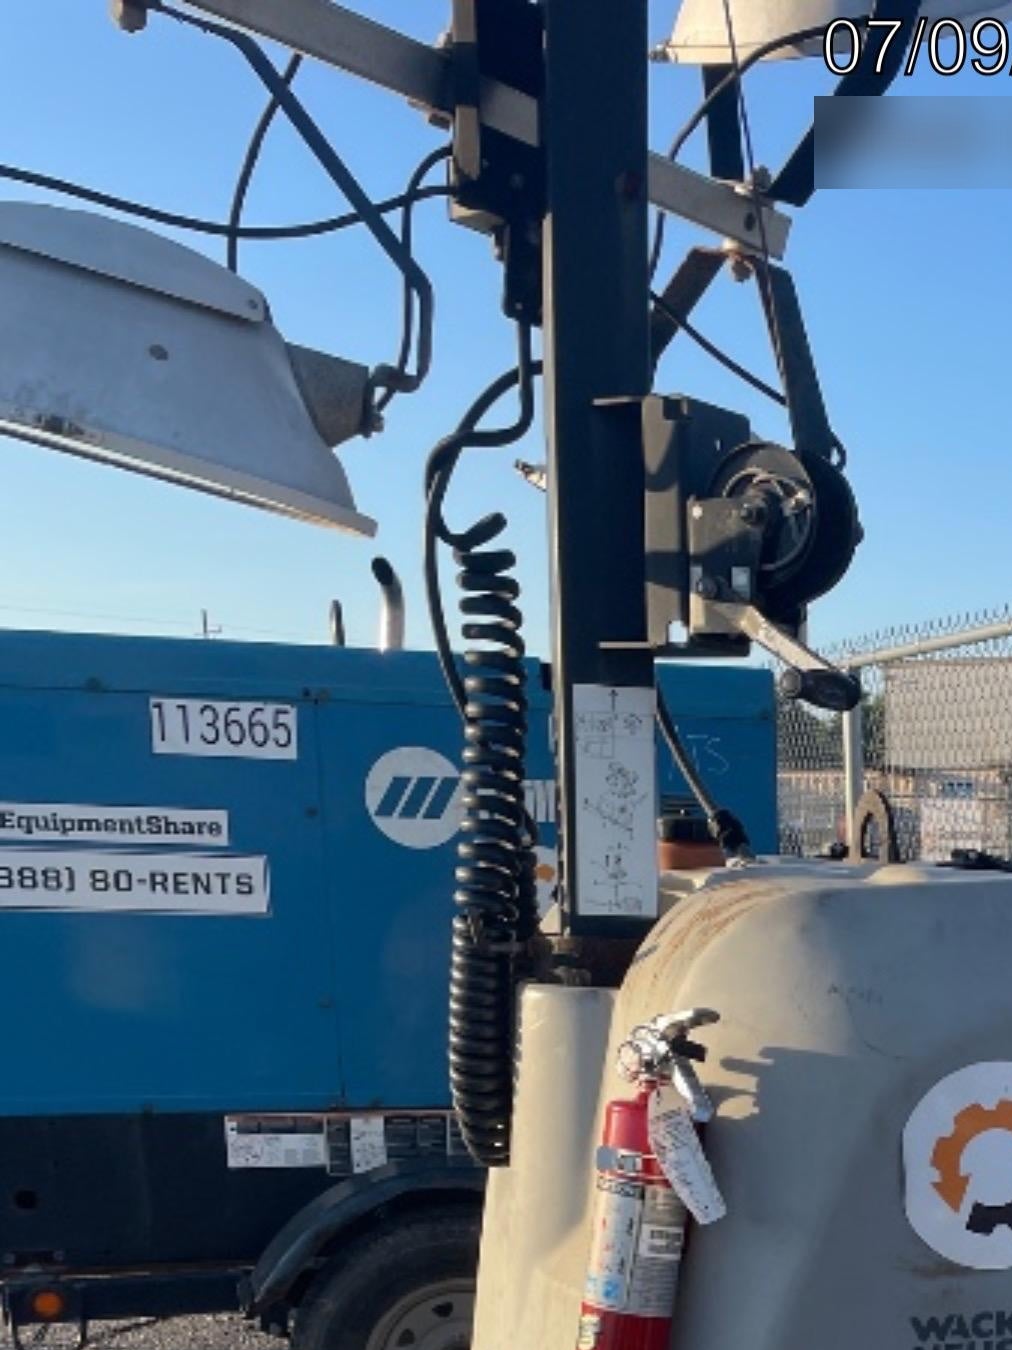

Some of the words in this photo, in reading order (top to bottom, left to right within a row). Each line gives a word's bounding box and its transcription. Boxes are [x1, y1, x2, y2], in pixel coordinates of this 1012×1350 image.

[152, 702, 292, 748] 113665
[0, 811, 223, 837] EquipmentShare
[90, 869, 254, 895] 80-RENTS
